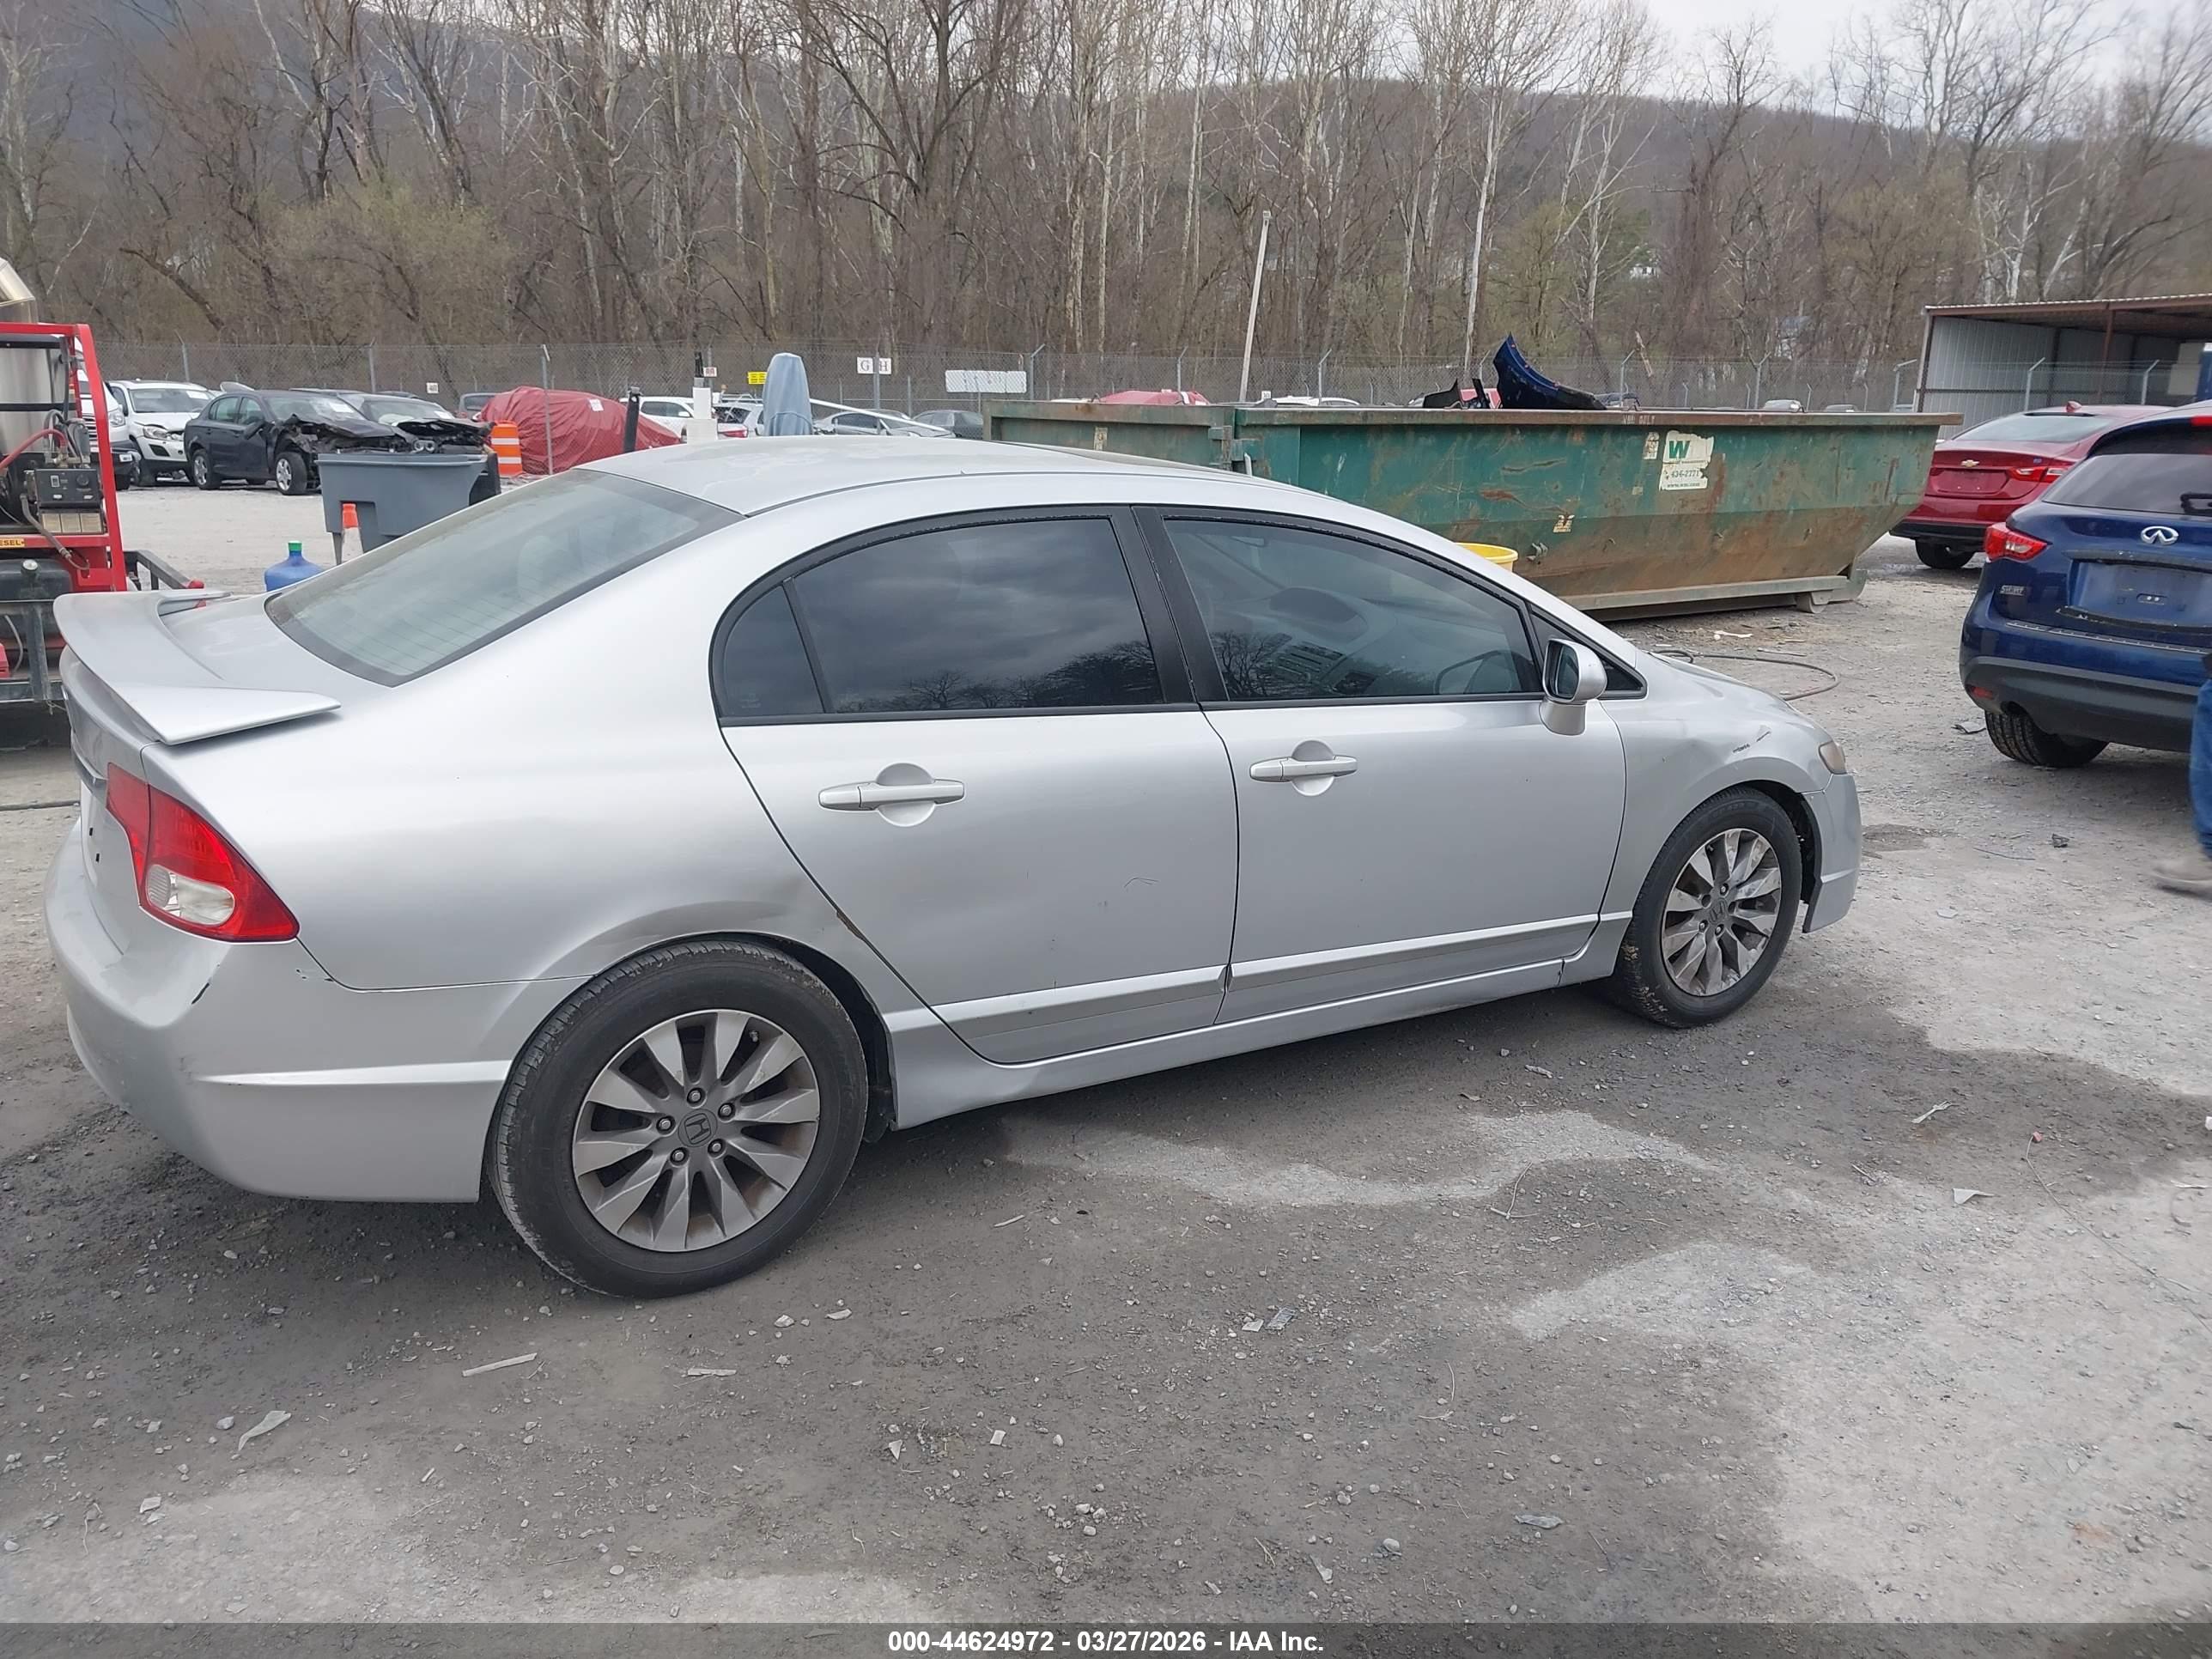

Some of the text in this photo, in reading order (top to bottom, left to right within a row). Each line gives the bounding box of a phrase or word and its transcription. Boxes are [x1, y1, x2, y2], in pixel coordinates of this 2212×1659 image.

[860, 359, 870, 371] G
[879, 360, 889, 372] H
[1668, 440, 1691, 459] W
